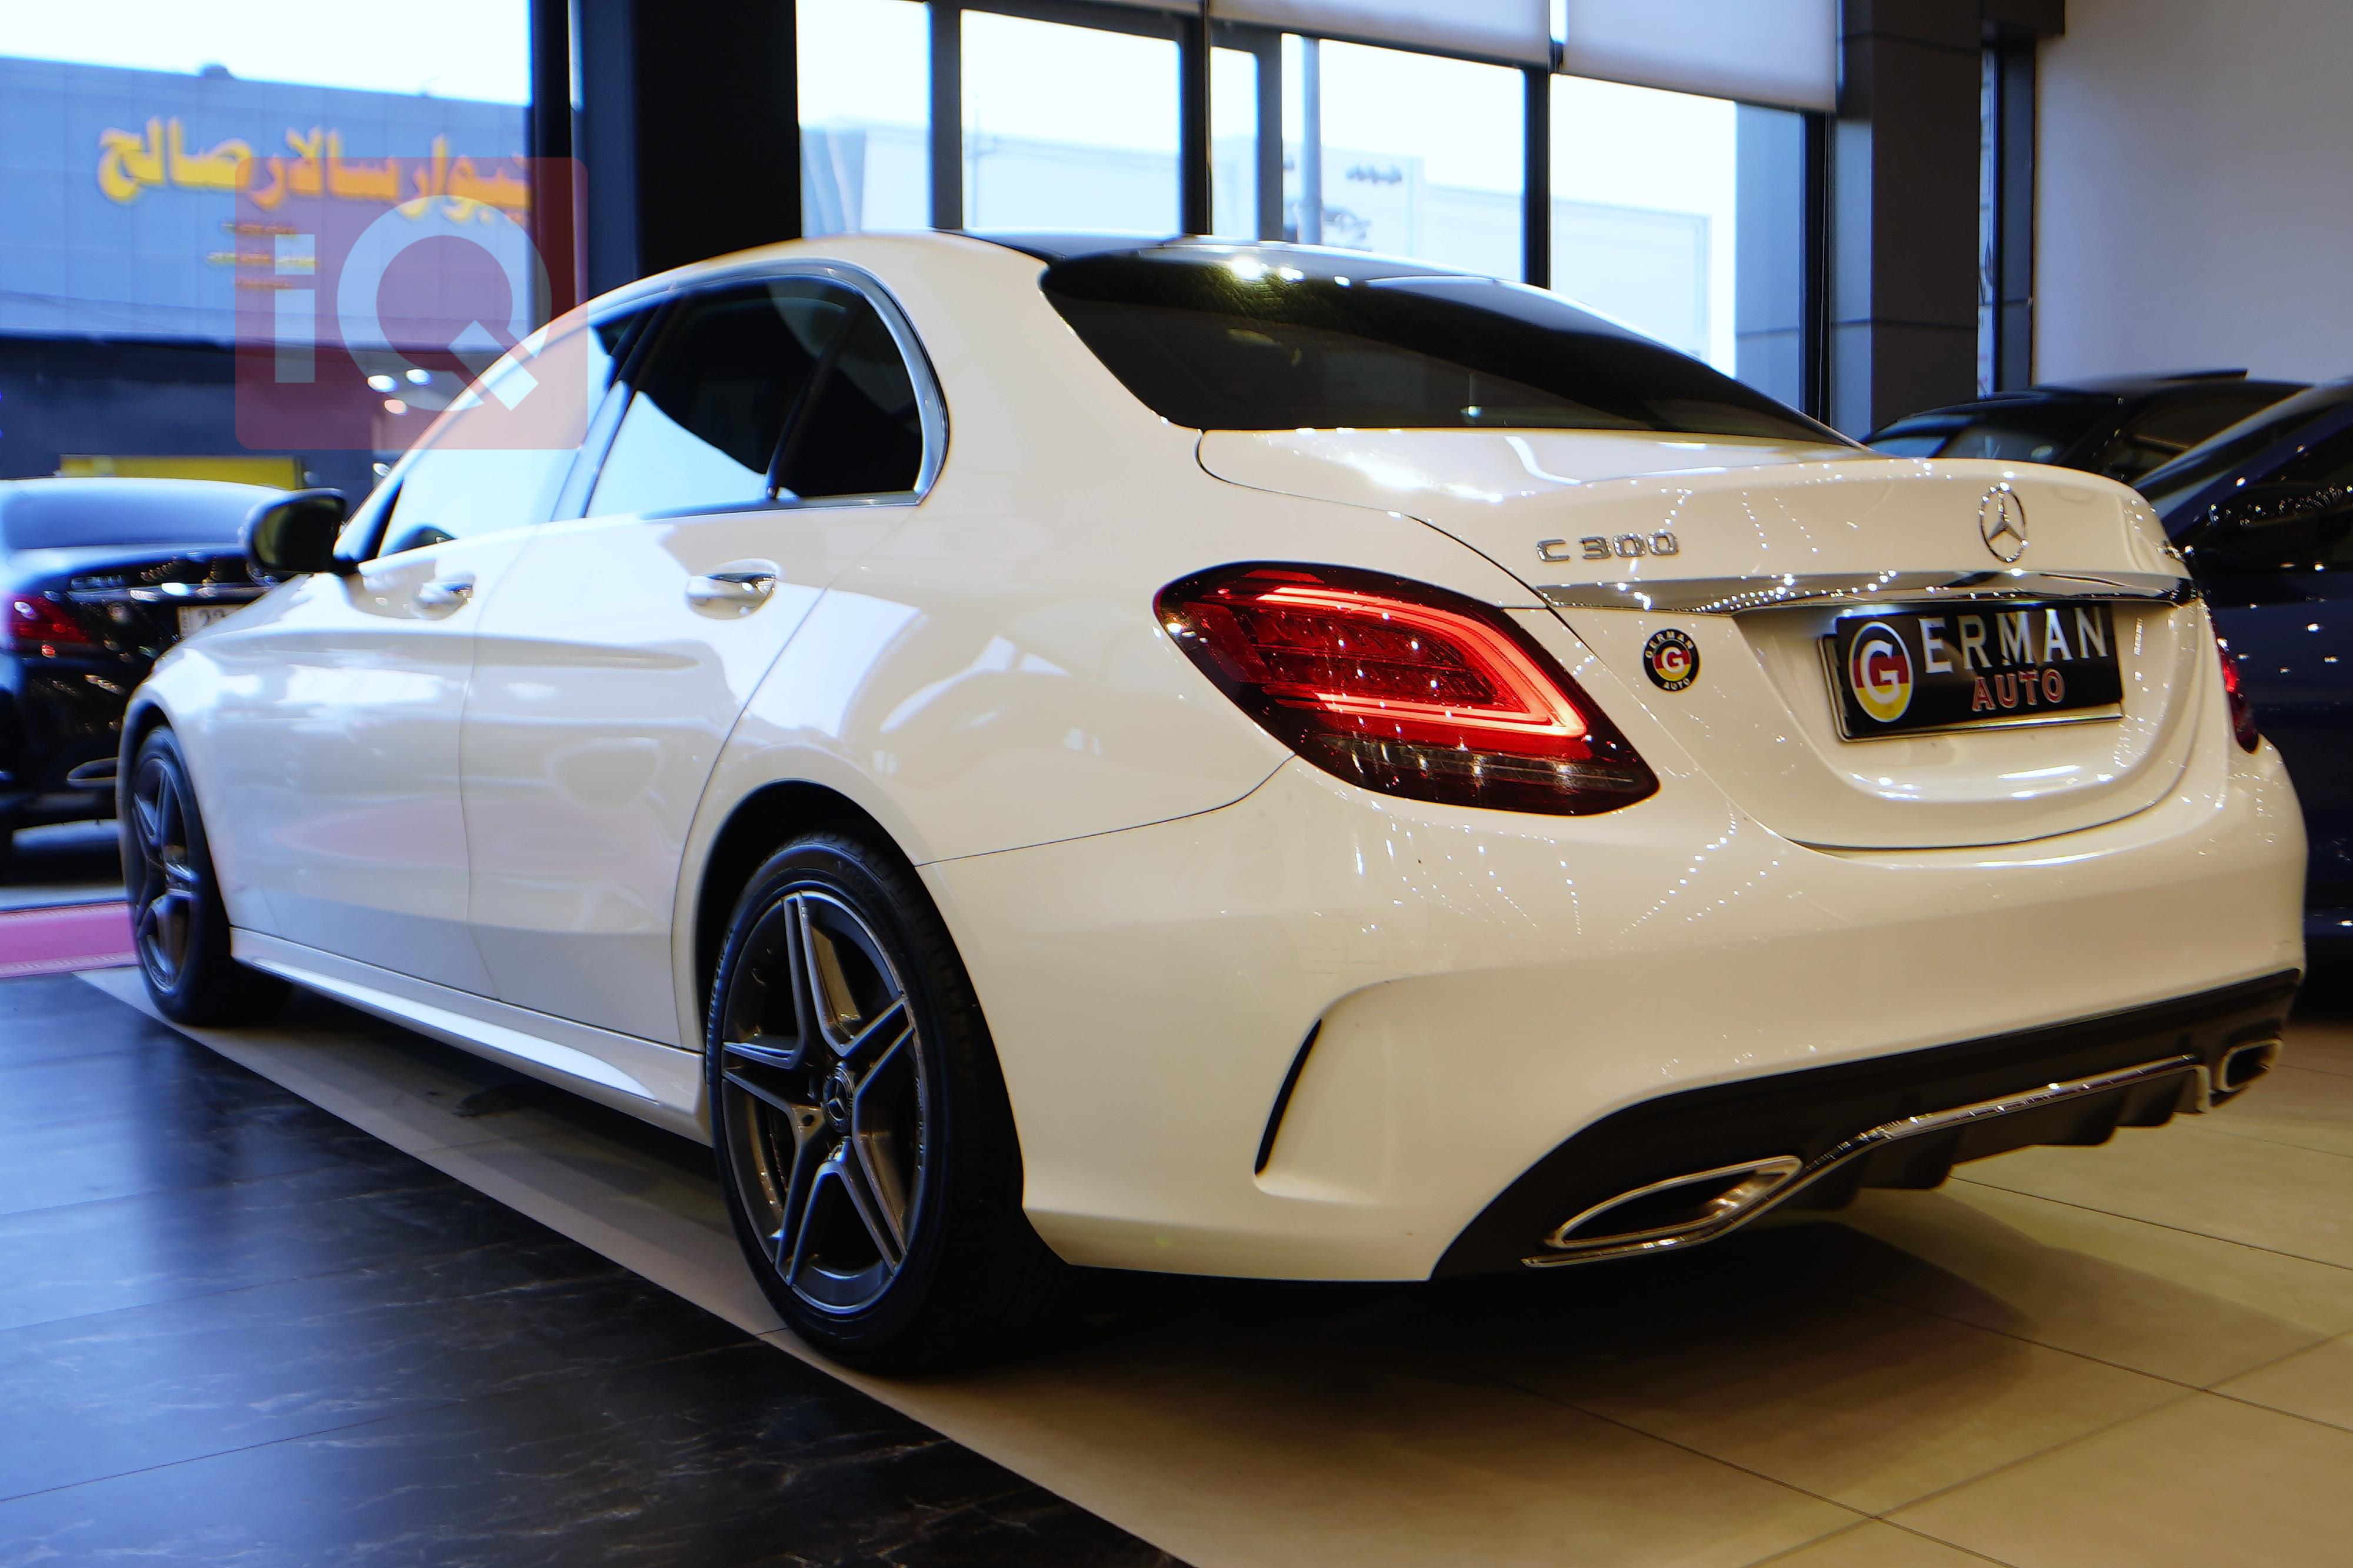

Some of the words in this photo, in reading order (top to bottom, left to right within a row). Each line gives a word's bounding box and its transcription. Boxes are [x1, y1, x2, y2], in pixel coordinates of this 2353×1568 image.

[98, 115, 253, 203] صالح
[1537, 539, 1570, 562] C
[1579, 528, 1678, 559] 300
[1661, 646, 1685, 673] G
[1663, 678, 1691, 690] AUTO
[1971, 668, 2065, 712] AUTO
